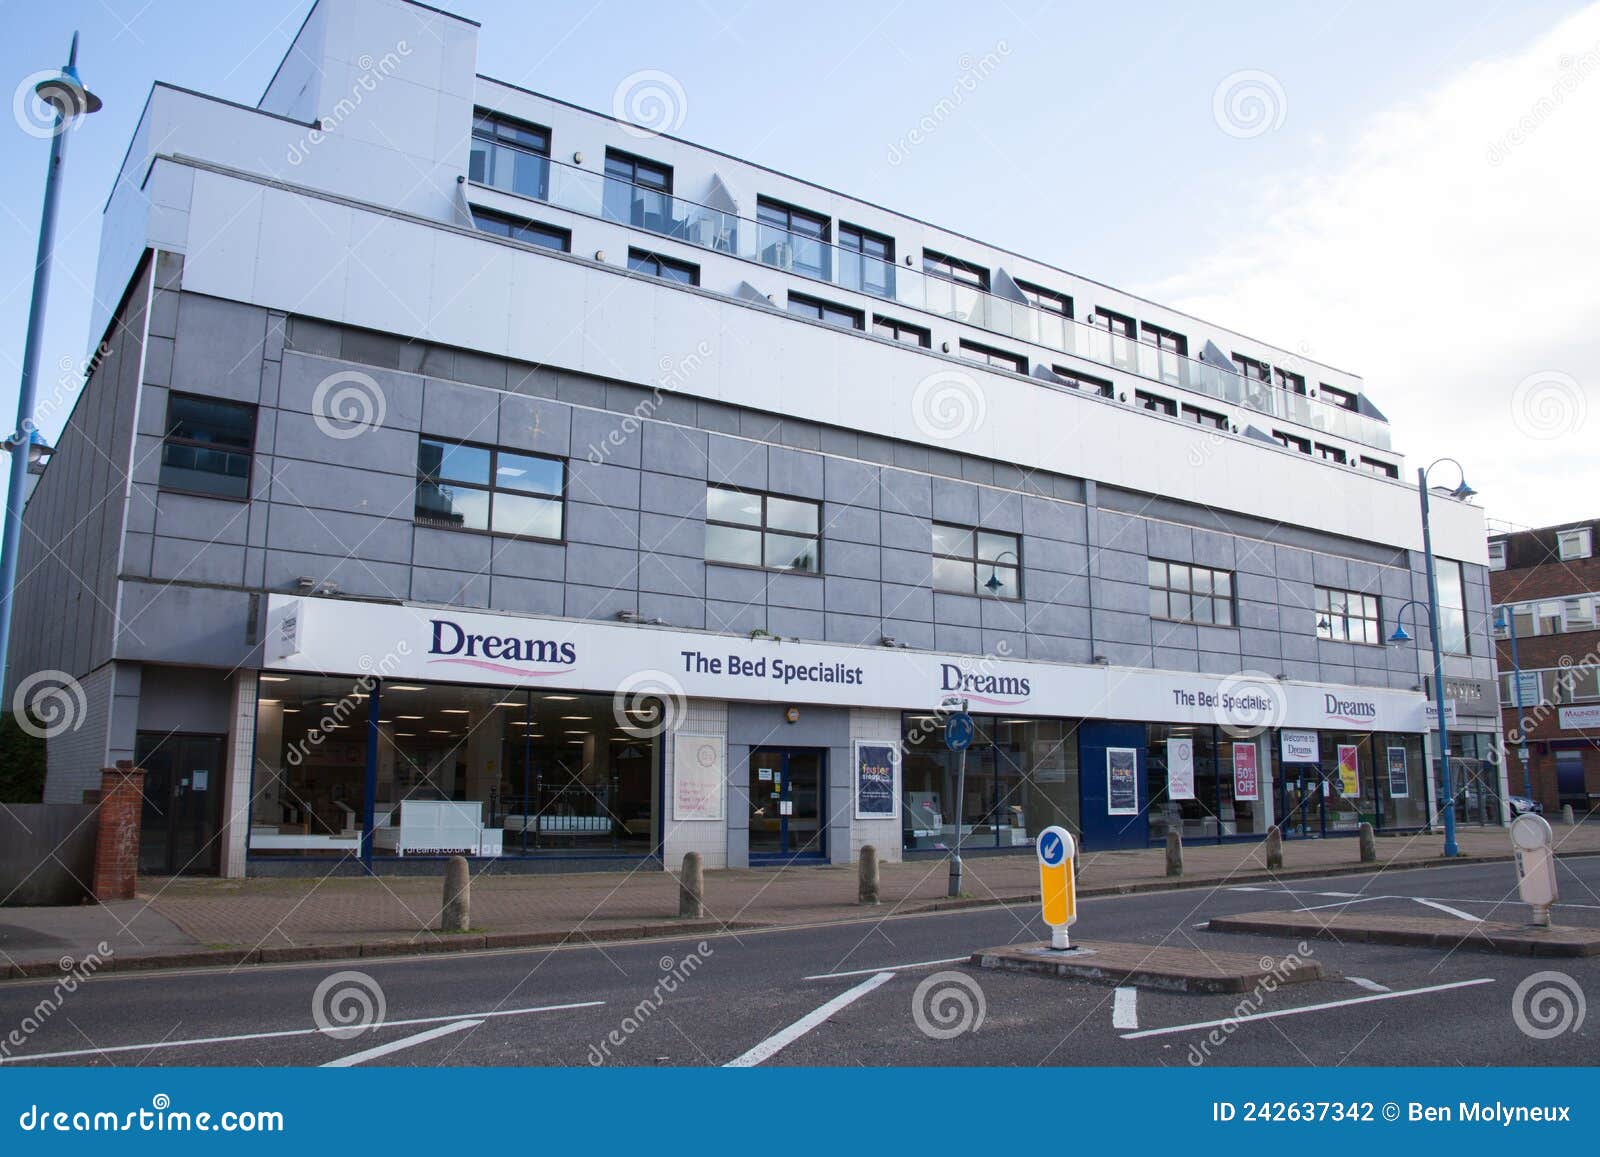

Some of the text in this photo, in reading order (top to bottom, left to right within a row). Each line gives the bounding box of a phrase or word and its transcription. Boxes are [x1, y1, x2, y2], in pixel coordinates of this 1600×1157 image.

[428, 619, 577, 665] Dreams
[681, 651, 863, 684] The Bed Specialist
[940, 663, 1030, 696] Dreams
[1173, 689, 1273, 712] The Bed Specialist
[1325, 693, 1376, 717] Dreams
[1283, 732, 1316, 743] Welcome to
[1287, 744, 1312, 754] Dreams
[1237, 767, 1257, 779] 50%
[1238, 780, 1255, 793] OFF
